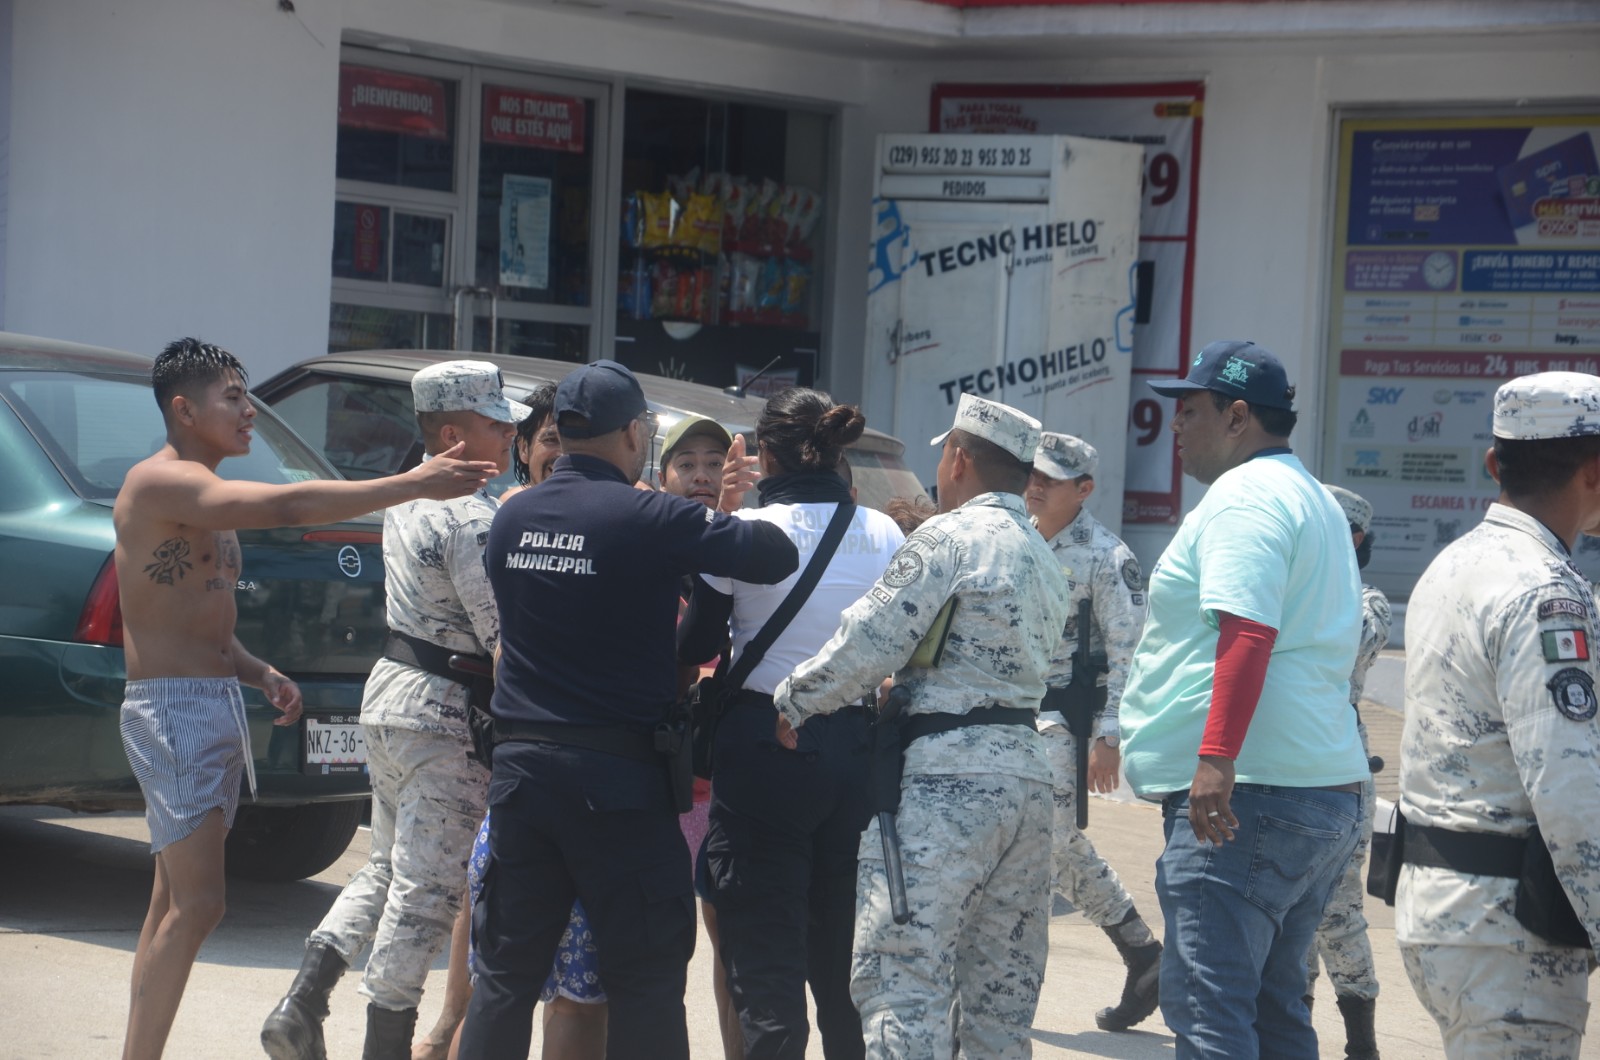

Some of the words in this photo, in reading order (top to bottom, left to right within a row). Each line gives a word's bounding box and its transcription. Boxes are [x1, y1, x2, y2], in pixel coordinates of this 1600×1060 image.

[352, 84, 433, 114] ¡BIENVENIDO!
[499, 95, 521, 113] NOS
[524, 98, 569, 119] ENCANTA
[960, 103, 986, 113] PARA
[491, 116, 512, 135] QUE
[515, 117, 544, 137] ESTÉS
[547, 120, 573, 142] AQUÍ
[944, 114, 967, 129] TUS
[970, 112, 1038, 132] REUNIONES
[889, 145, 917, 168] (229)
[921, 146, 940, 165] 955
[943, 147, 957, 166] 20
[961, 148, 973, 166] 23
[978, 147, 997, 166] 955
[1001, 147, 1015, 166] 20
[1019, 147, 1031, 166] 25
[943, 180, 986, 197] PEDIDOS
[919, 229, 1014, 277] TECNO
[1023, 219, 1097, 251] HIELO
[1512, 254, 1554, 268] DINERO
[1557, 254, 1566, 268] Y
[939, 338, 1106, 405] TECNOHIELO
[1365, 359, 1390, 376] Paga
[1393, 360, 1411, 373] Tus
[1414, 360, 1461, 374] Servicios
[1464, 361, 1481, 374] Las
[1484, 355, 1508, 376] 24
[1367, 387, 1406, 405] SKY
[1411, 494, 1465, 510] ESCANEA
[1469, 497, 1478, 510] Y
[519, 531, 585, 552] POLICIA
[505, 552, 598, 575] MUNICIPAL
